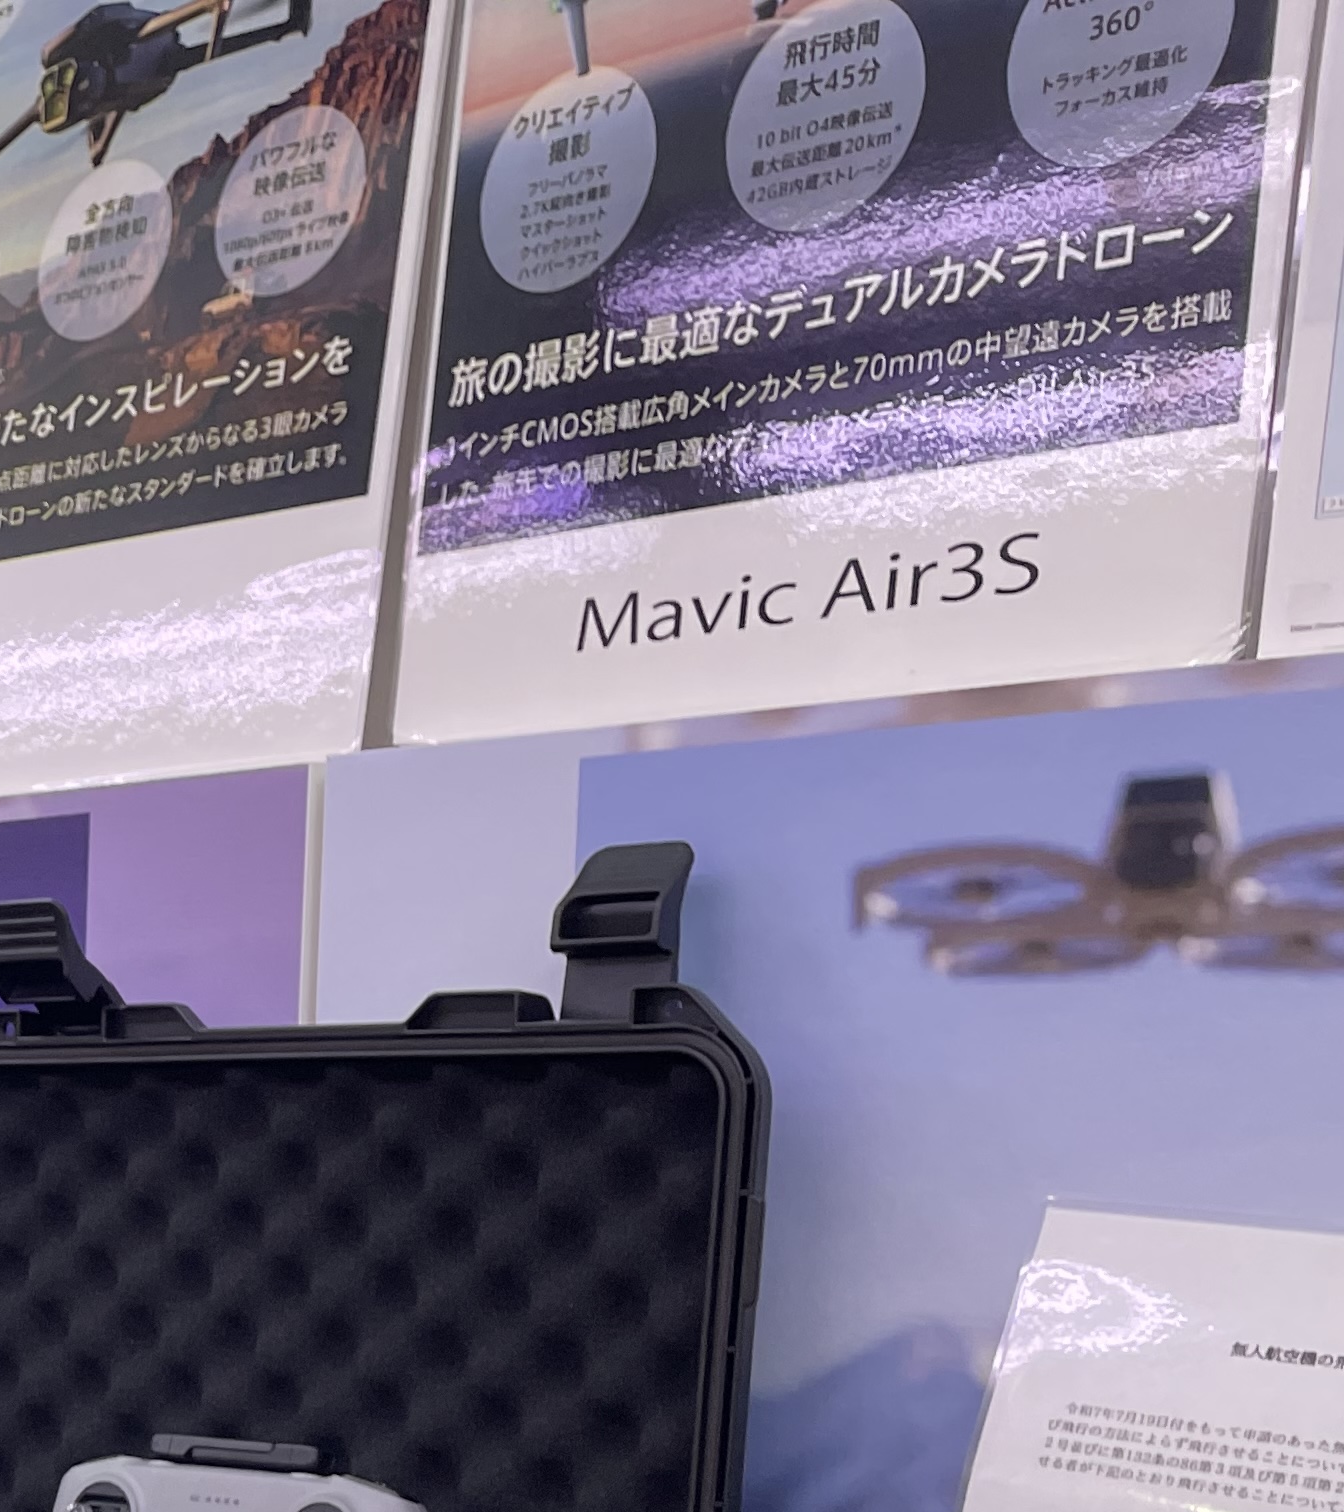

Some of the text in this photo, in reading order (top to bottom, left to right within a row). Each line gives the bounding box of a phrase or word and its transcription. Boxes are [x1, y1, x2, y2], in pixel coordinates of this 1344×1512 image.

[783, 19, 881, 70] 飛行時間
[776, 57, 881, 108] 最大45分
[1042, 44, 1188, 94] トラッキング最適化
[514, 80, 637, 139] クリエイティブ
[1054, 76, 1169, 117] フォーカス維持
[250, 130, 338, 171] パワフルな
[548, 130, 591, 166] 撮影
[757, 130, 776, 149] 10
[780, 125, 801, 144] bit
[253, 161, 327, 198] 映像伝送
[527, 163, 609, 198] フリーパノラマ
[747, 155, 892, 205] 42GB内蔵ストレージ
[83, 194, 134, 227] 全方向
[519, 205, 608, 240] マスターショット
[65, 216, 149, 256] 障害物検知
[519, 227, 603, 261] クイックショット
[448, 210, 1233, 408] 旅の撮影に最適なデュアルカメラドローン
[446, 288, 1233, 462] 1インチCMOS搭載広角メインカメラと70mmの中望遠カメラを搭載
[576, 531, 1042, 655] Mavic Air3S
